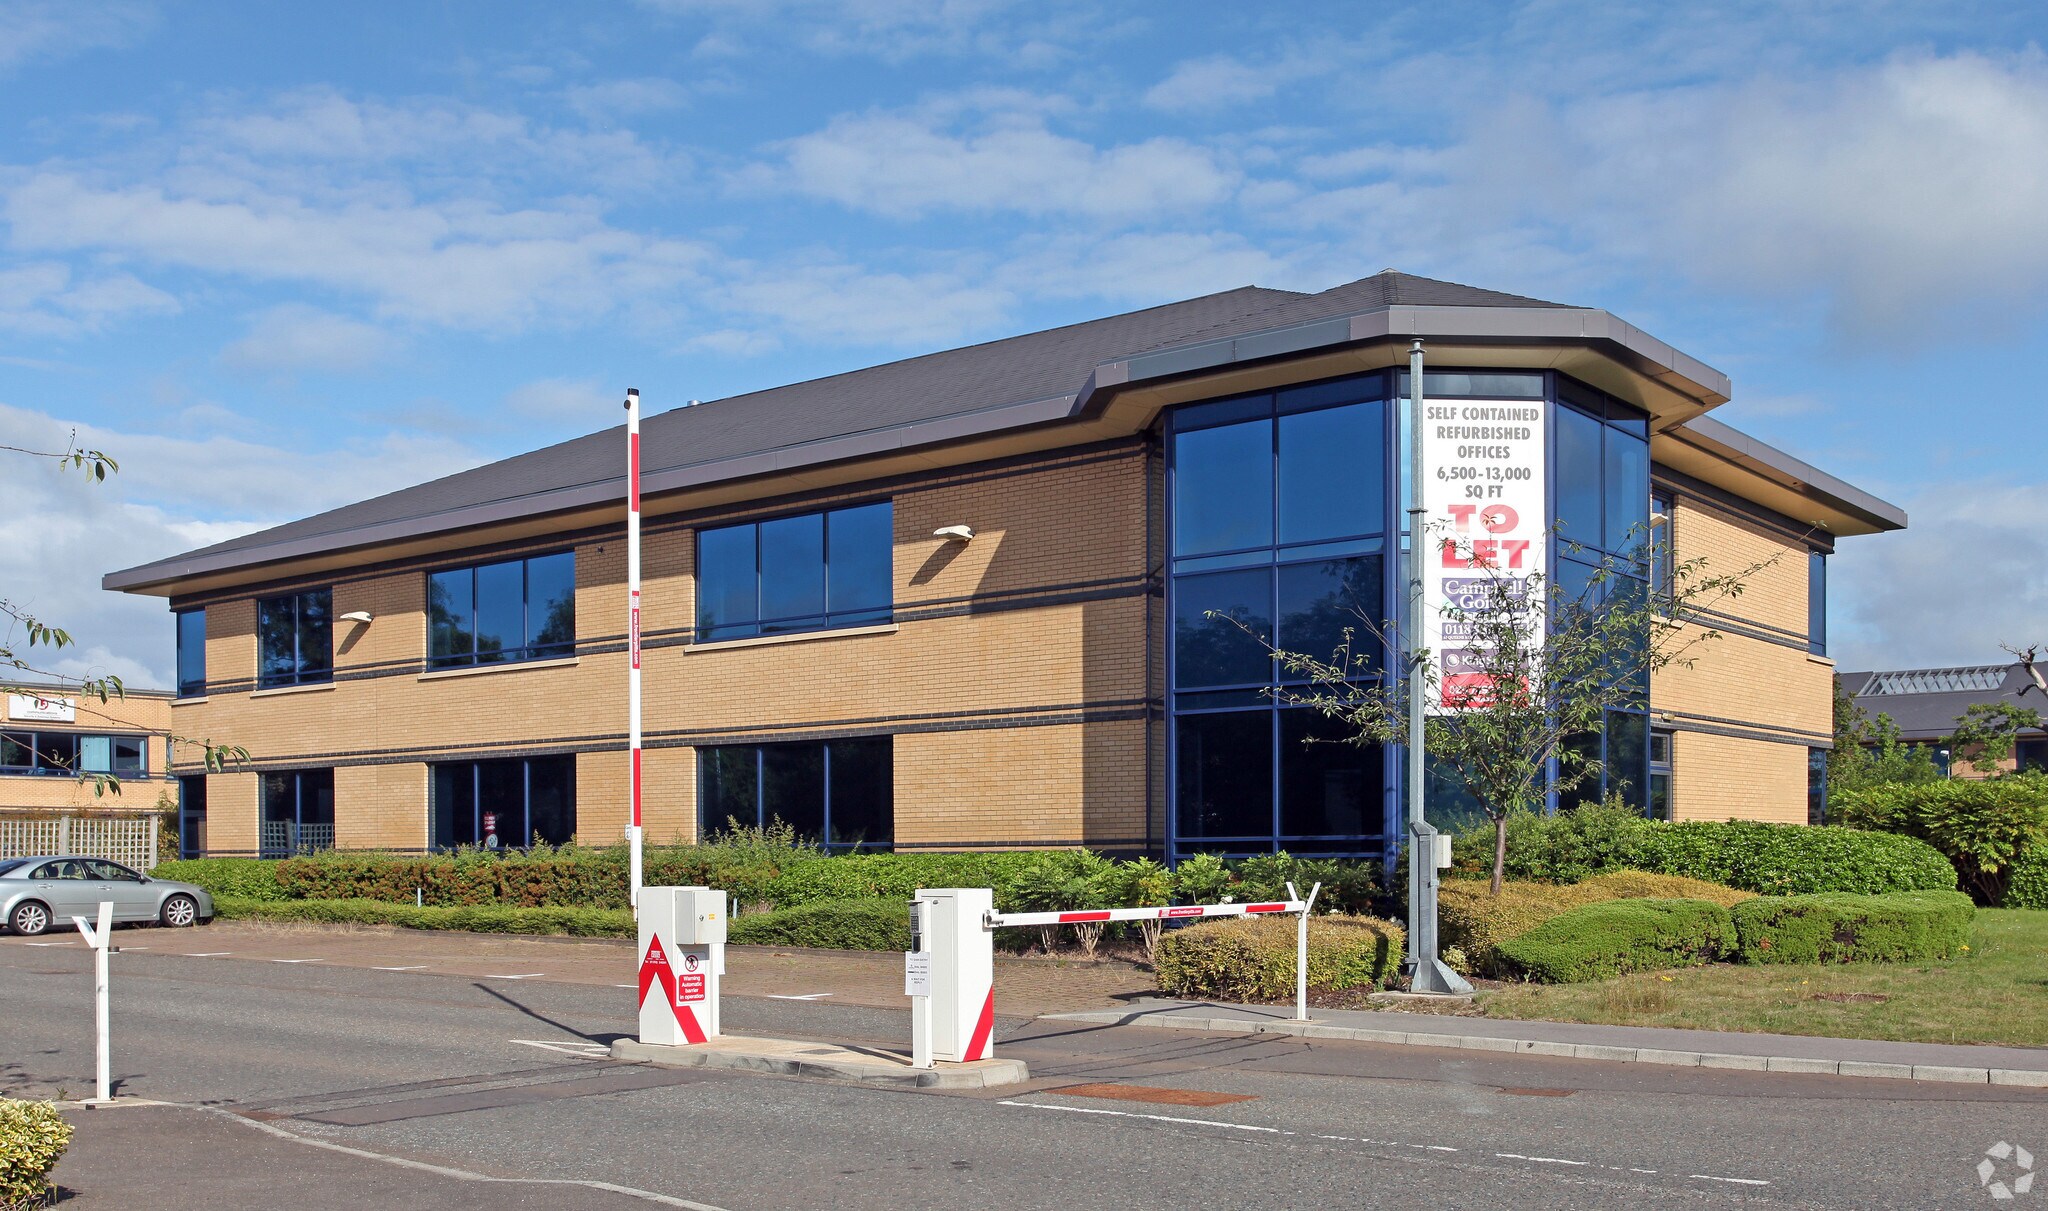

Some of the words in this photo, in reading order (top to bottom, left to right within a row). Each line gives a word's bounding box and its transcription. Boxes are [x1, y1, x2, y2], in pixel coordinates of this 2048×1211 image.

[1427, 406, 1457, 420] SELF
[1462, 407, 1539, 421] CONTAINED
[1436, 426, 1531, 440] REFURBISHED
[1457, 445, 1511, 459] OFFICES
[1465, 484, 1484, 499] SQ
[1488, 485, 1504, 498] FT
[1447, 504, 1520, 534] TO
[1441, 539, 1530, 569] LET
[1444, 624, 1472, 635] 0118
